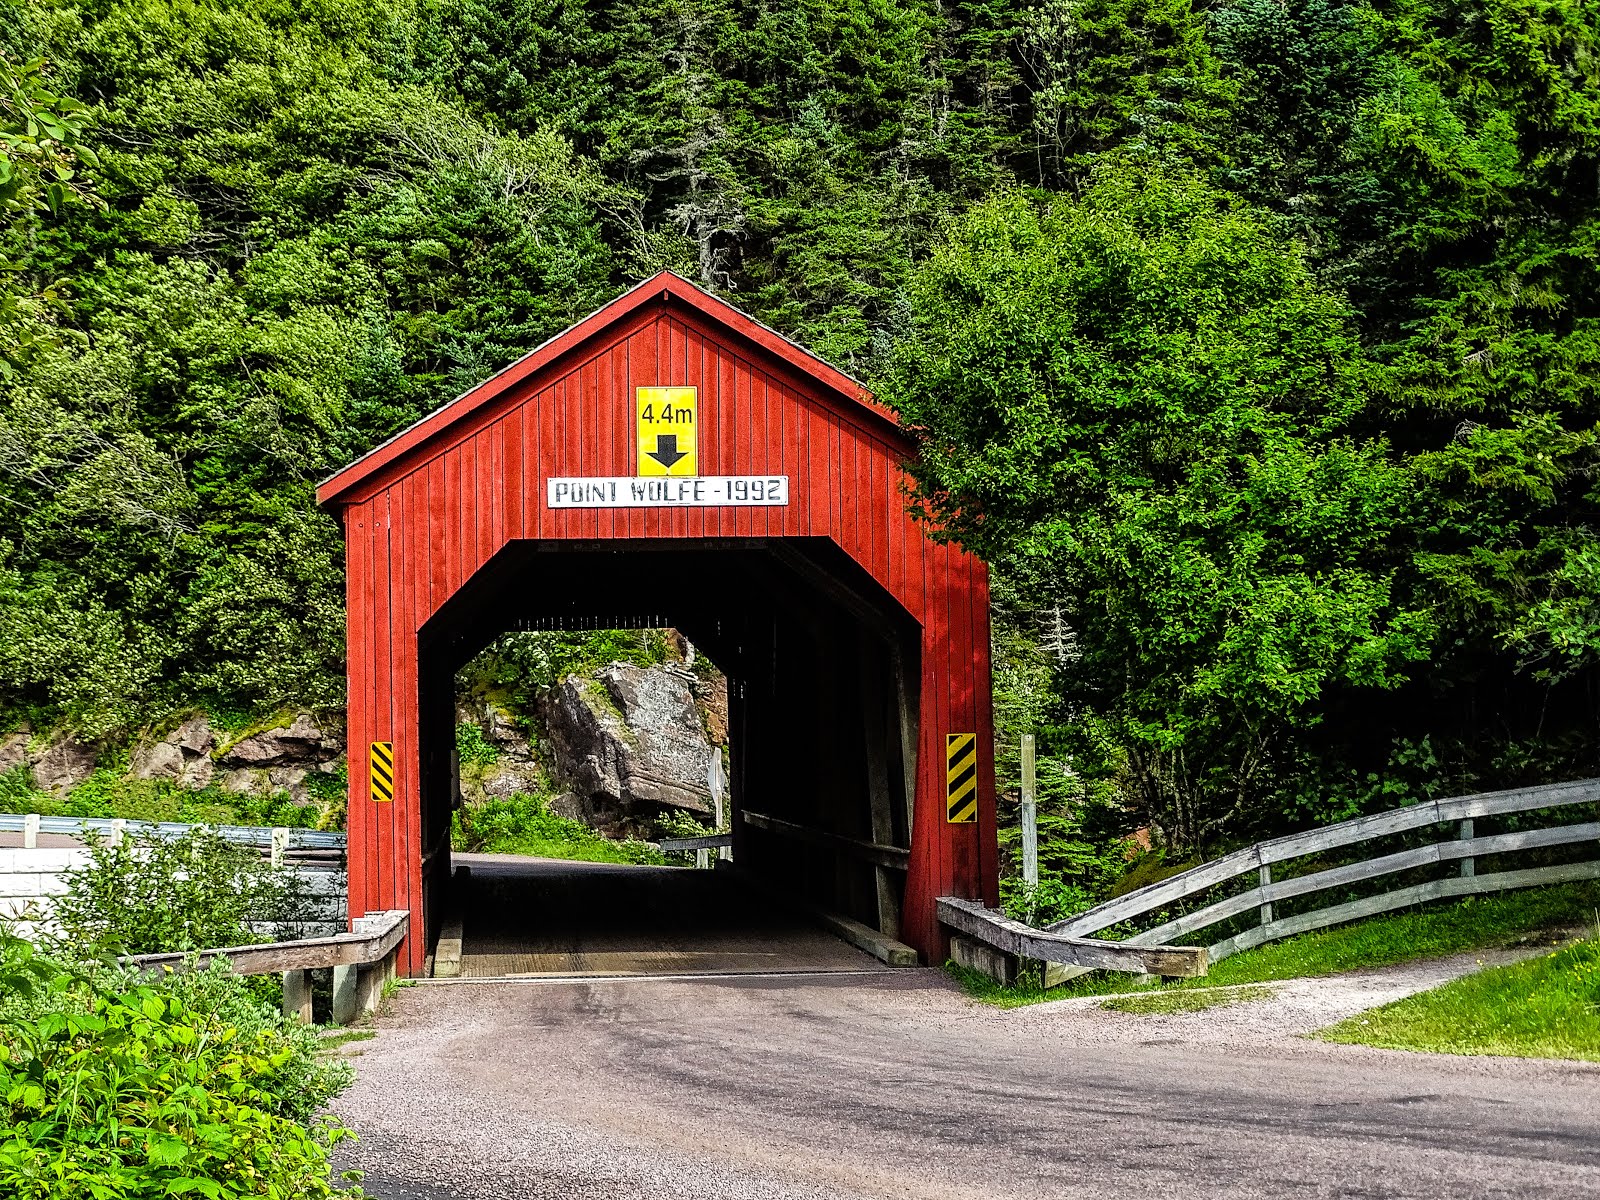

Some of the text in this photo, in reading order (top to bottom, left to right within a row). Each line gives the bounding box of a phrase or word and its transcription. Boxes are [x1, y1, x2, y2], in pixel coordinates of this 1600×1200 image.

[641, 403, 693, 424] 4.4m
[555, 481, 617, 503] POINT
[630, 480, 706, 502] WOLFE
